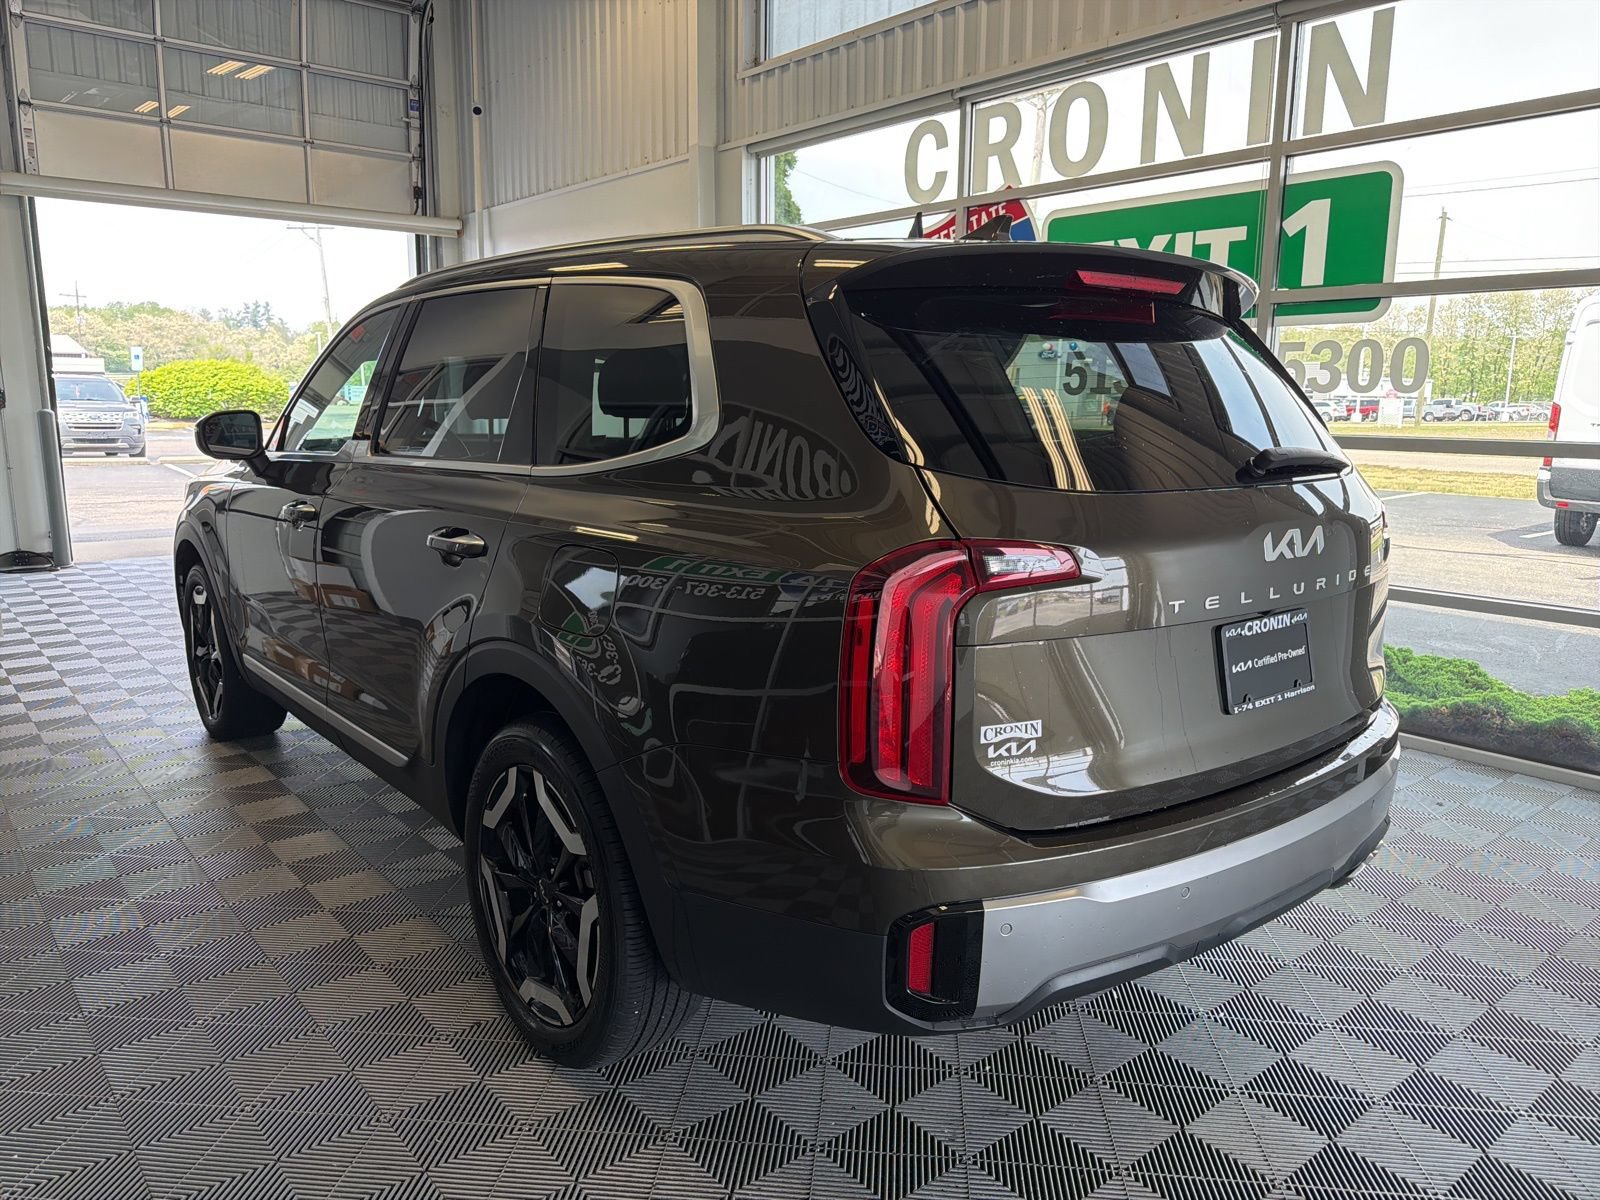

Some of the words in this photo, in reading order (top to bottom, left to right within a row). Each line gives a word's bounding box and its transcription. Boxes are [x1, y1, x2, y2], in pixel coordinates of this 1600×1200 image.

[904, 7, 1396, 204] CRONIN
[1283, 198, 1331, 287] 1
[1263, 525, 1325, 562] KIA
[1169, 564, 1372, 615] TELLURIDE
[1244, 613, 1291, 636] CRONIN
[1253, 653, 1278, 668] Certified
[1278, 645, 1306, 661] Pre-Owned
[1233, 702, 1254, 714] I-74
[1255, 696, 1276, 708] EXIT
[1277, 694, 1283, 702] 1
[1284, 684, 1316, 698] Harrison
[983, 721, 1040, 742] CRONIN
[987, 739, 1037, 758] KIA
[990, 756, 1034, 767] croninkia.com
